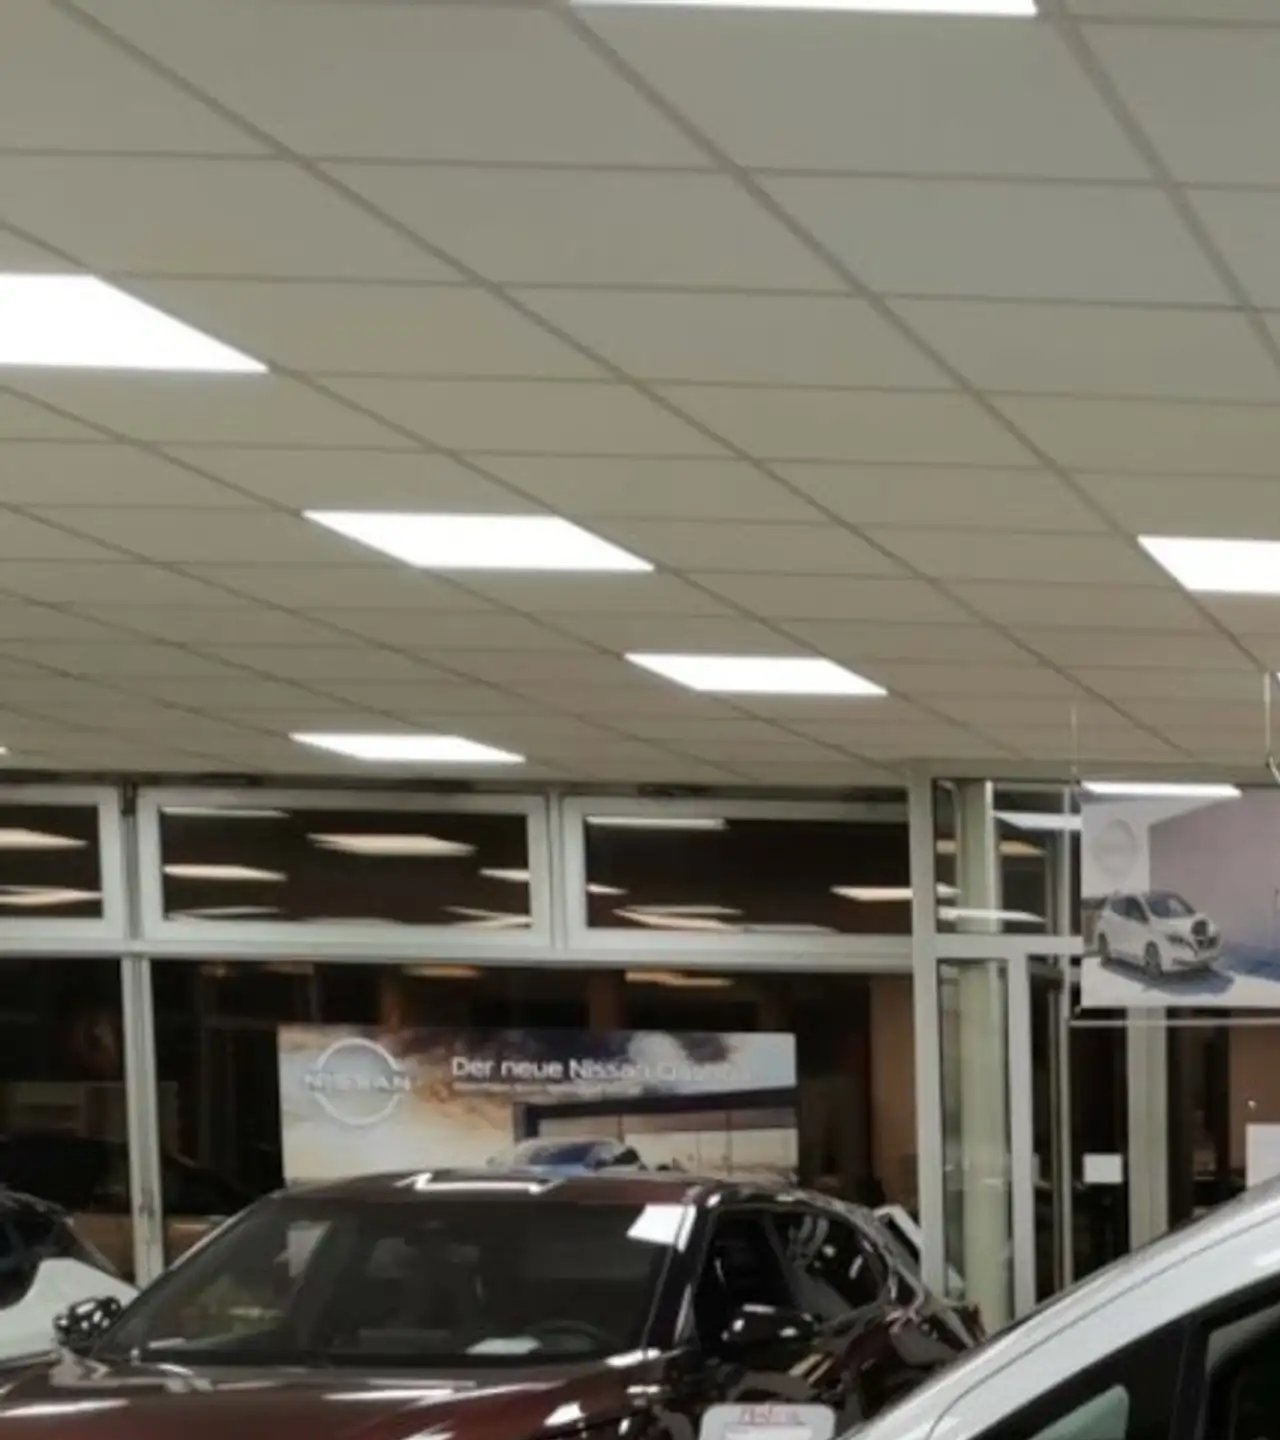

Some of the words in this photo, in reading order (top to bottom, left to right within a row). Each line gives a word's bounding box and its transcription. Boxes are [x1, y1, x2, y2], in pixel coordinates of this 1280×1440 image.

[452, 1056, 495, 1078] Der
[501, 1060, 564, 1080] neue
[568, 1057, 649, 1080] Nissan
